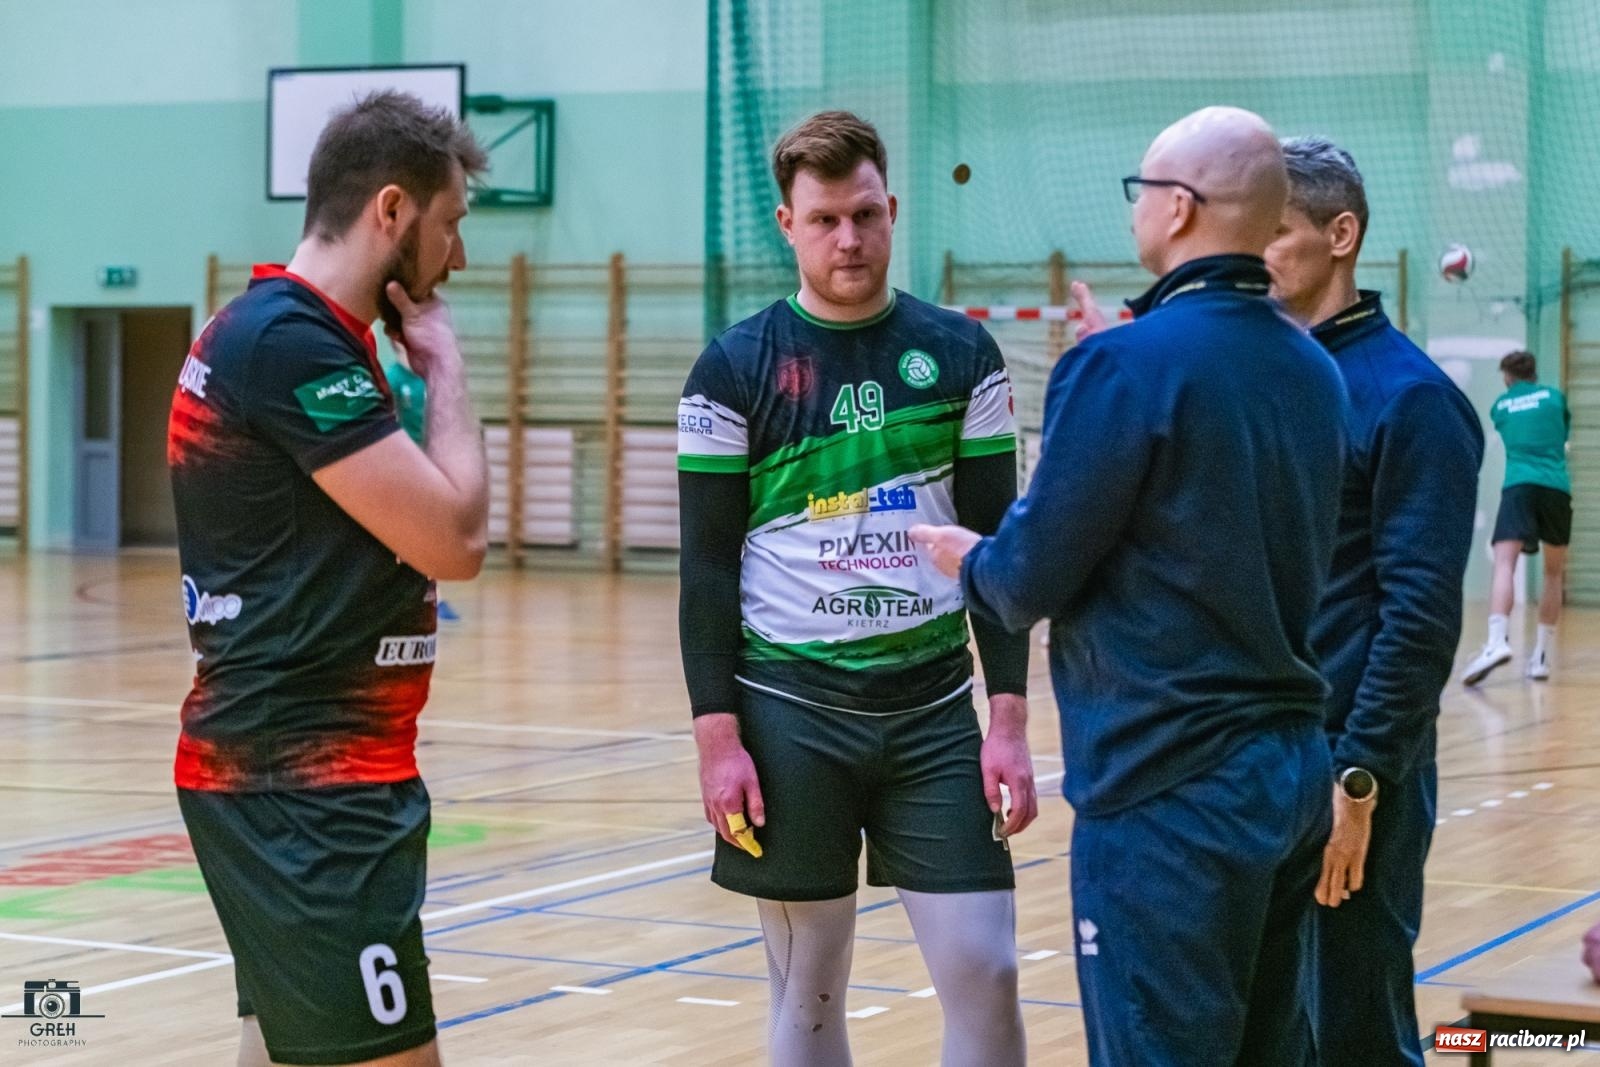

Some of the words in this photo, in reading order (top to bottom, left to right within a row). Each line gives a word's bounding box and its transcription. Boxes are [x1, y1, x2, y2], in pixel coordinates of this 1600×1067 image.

[679, 414, 712, 428] ECO
[830, 381, 885, 434] 49
[847, 619, 890, 629] KIETRZ
[359, 943, 407, 1025] 6
